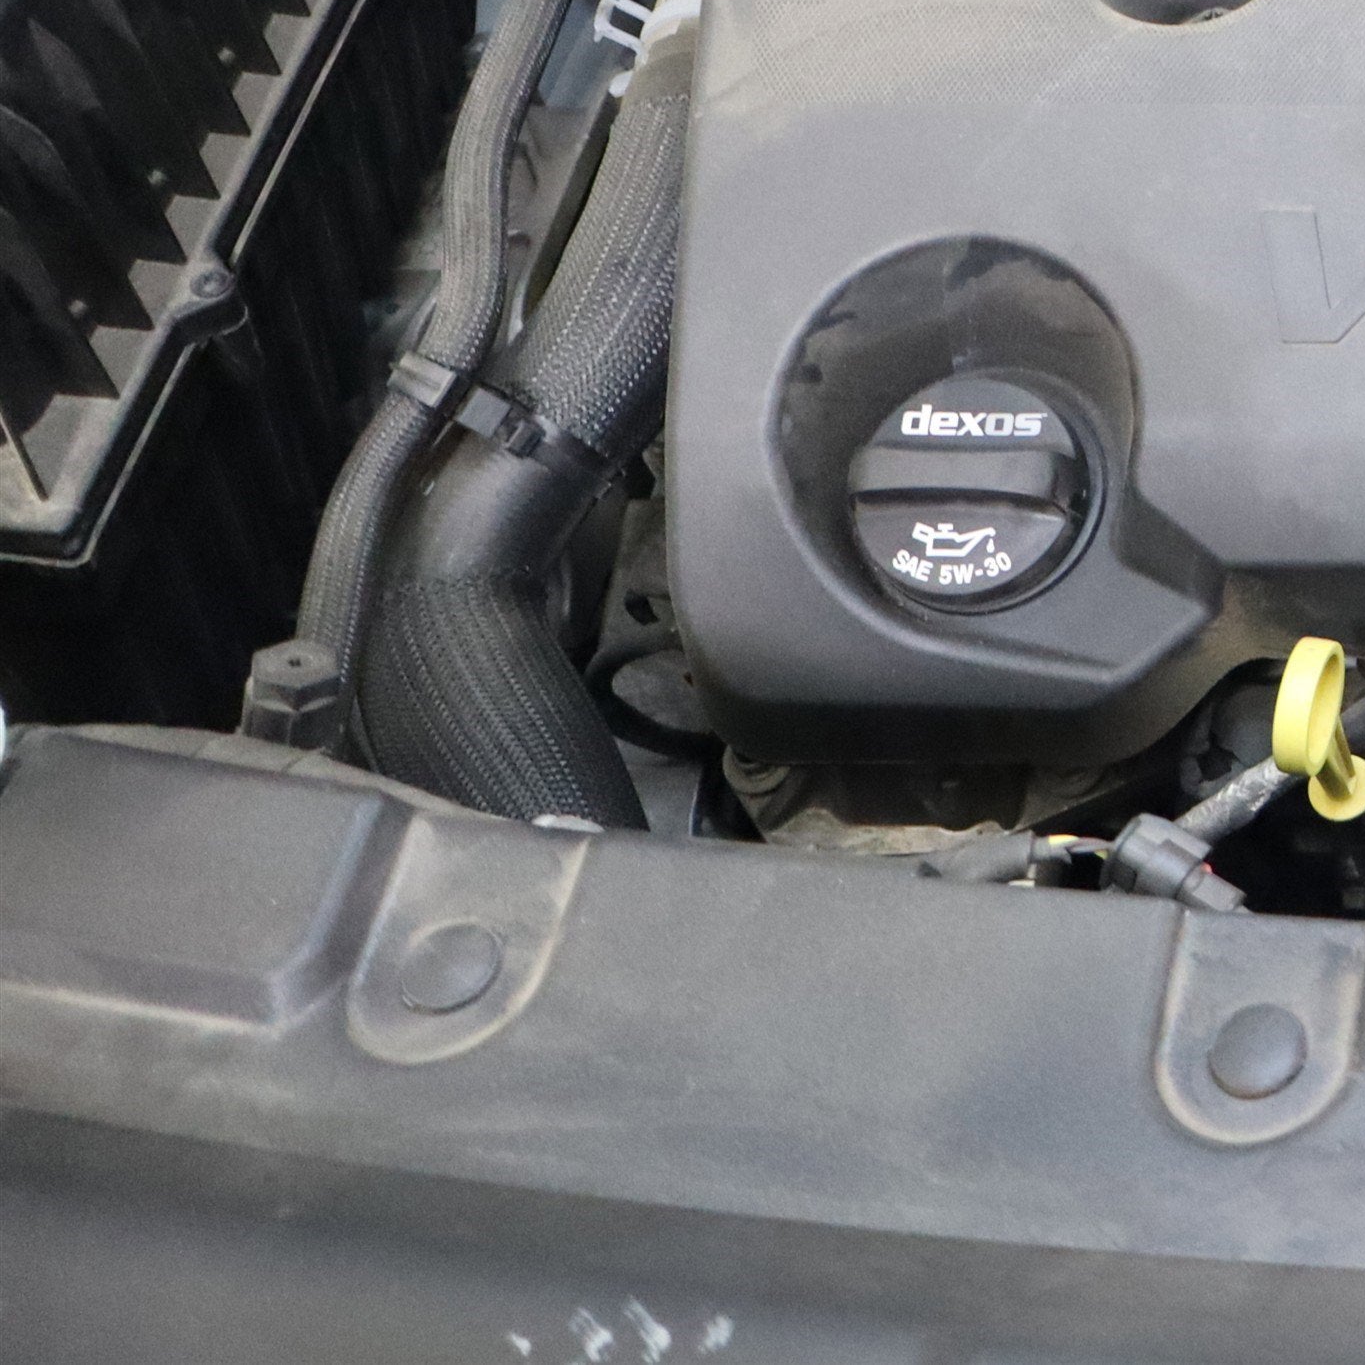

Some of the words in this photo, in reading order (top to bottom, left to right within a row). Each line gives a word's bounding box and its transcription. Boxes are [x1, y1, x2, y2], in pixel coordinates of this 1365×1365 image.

[901, 404, 1043, 436] dexos
[892, 549, 933, 582] SAE
[939, 551, 1012, 584] 5W-30
